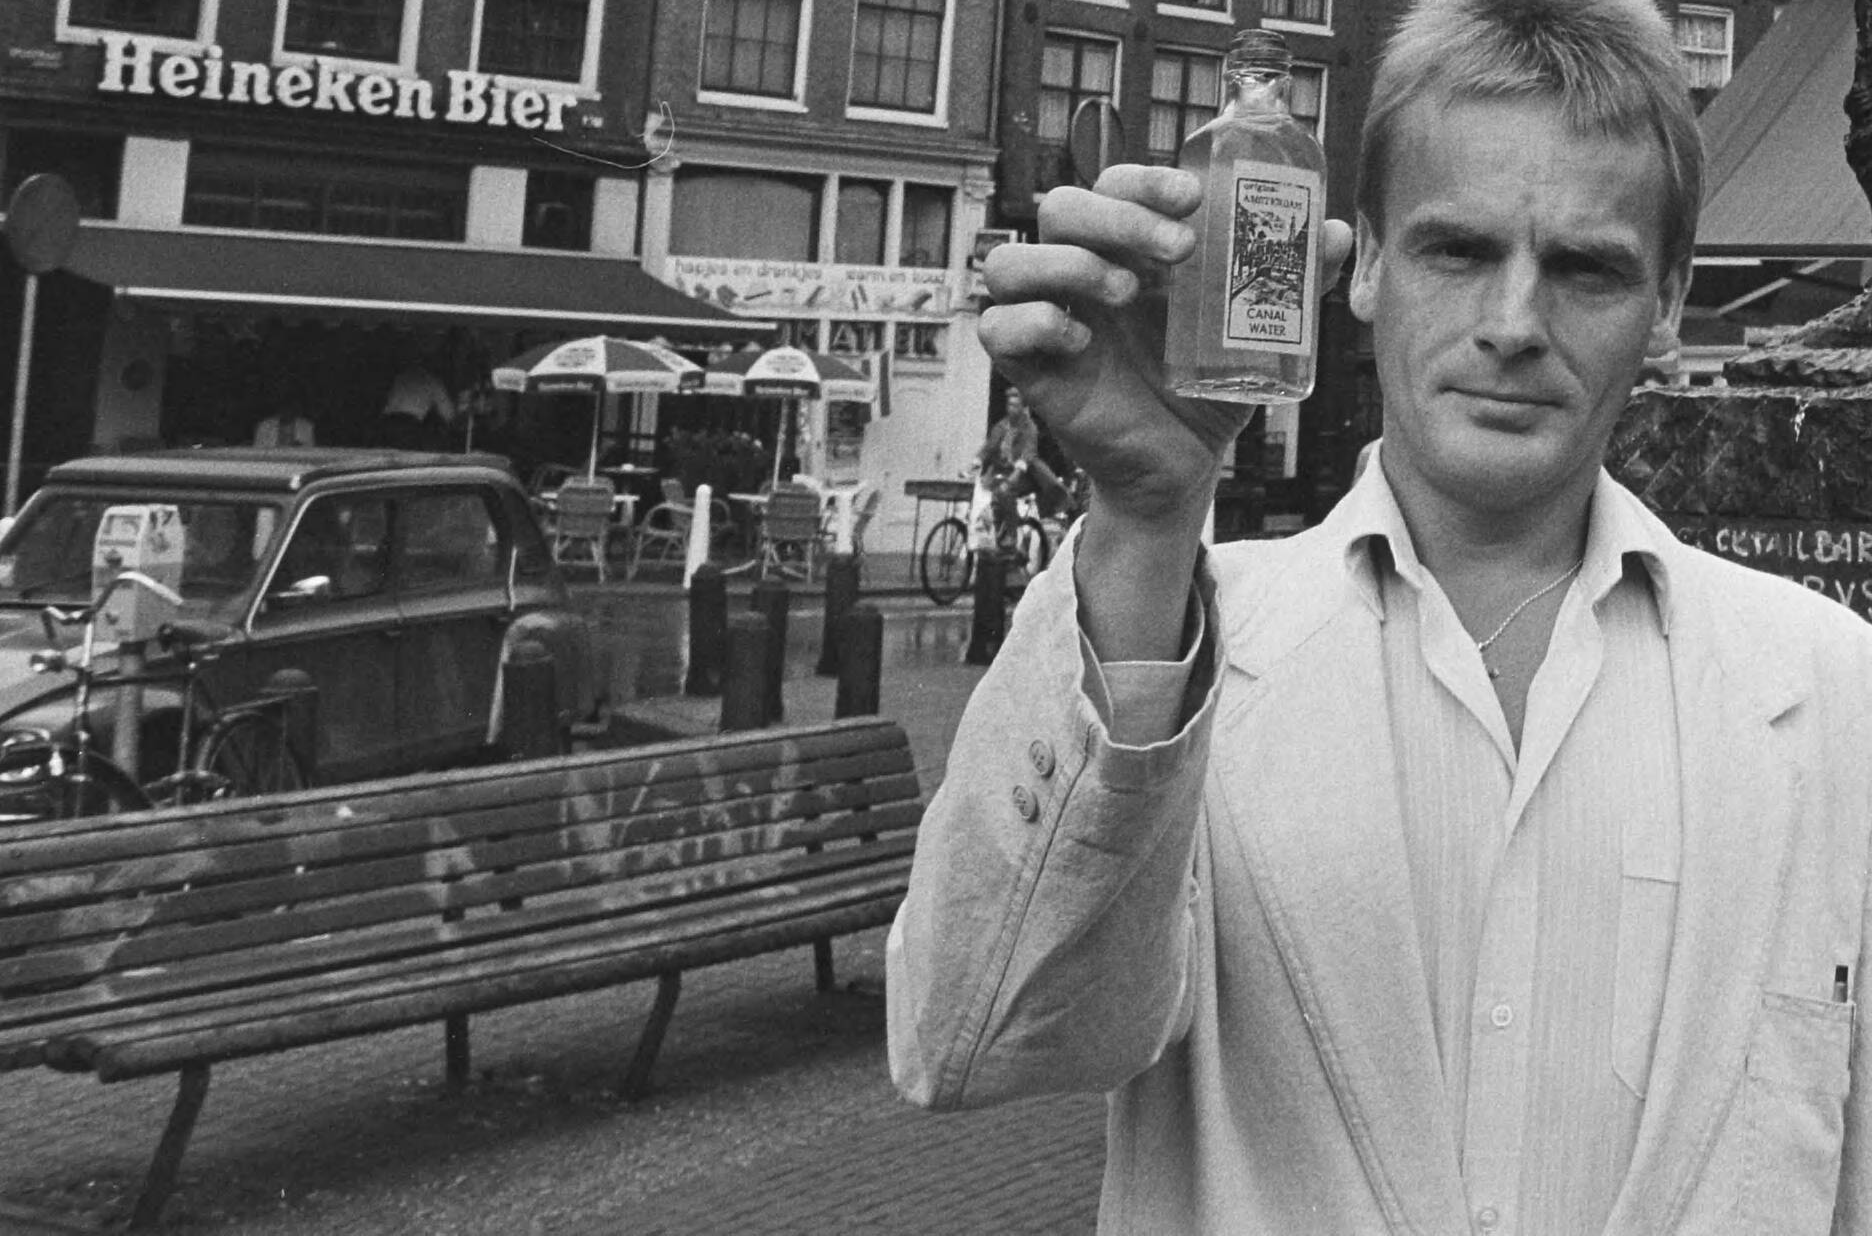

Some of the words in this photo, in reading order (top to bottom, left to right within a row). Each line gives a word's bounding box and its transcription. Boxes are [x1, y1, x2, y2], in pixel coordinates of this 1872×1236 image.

[98, 37, 437, 121] Heineken
[446, 68, 579, 133] Bier
[1246, 308, 1288, 322] CANAL
[1249, 323, 1287, 337] WATER
